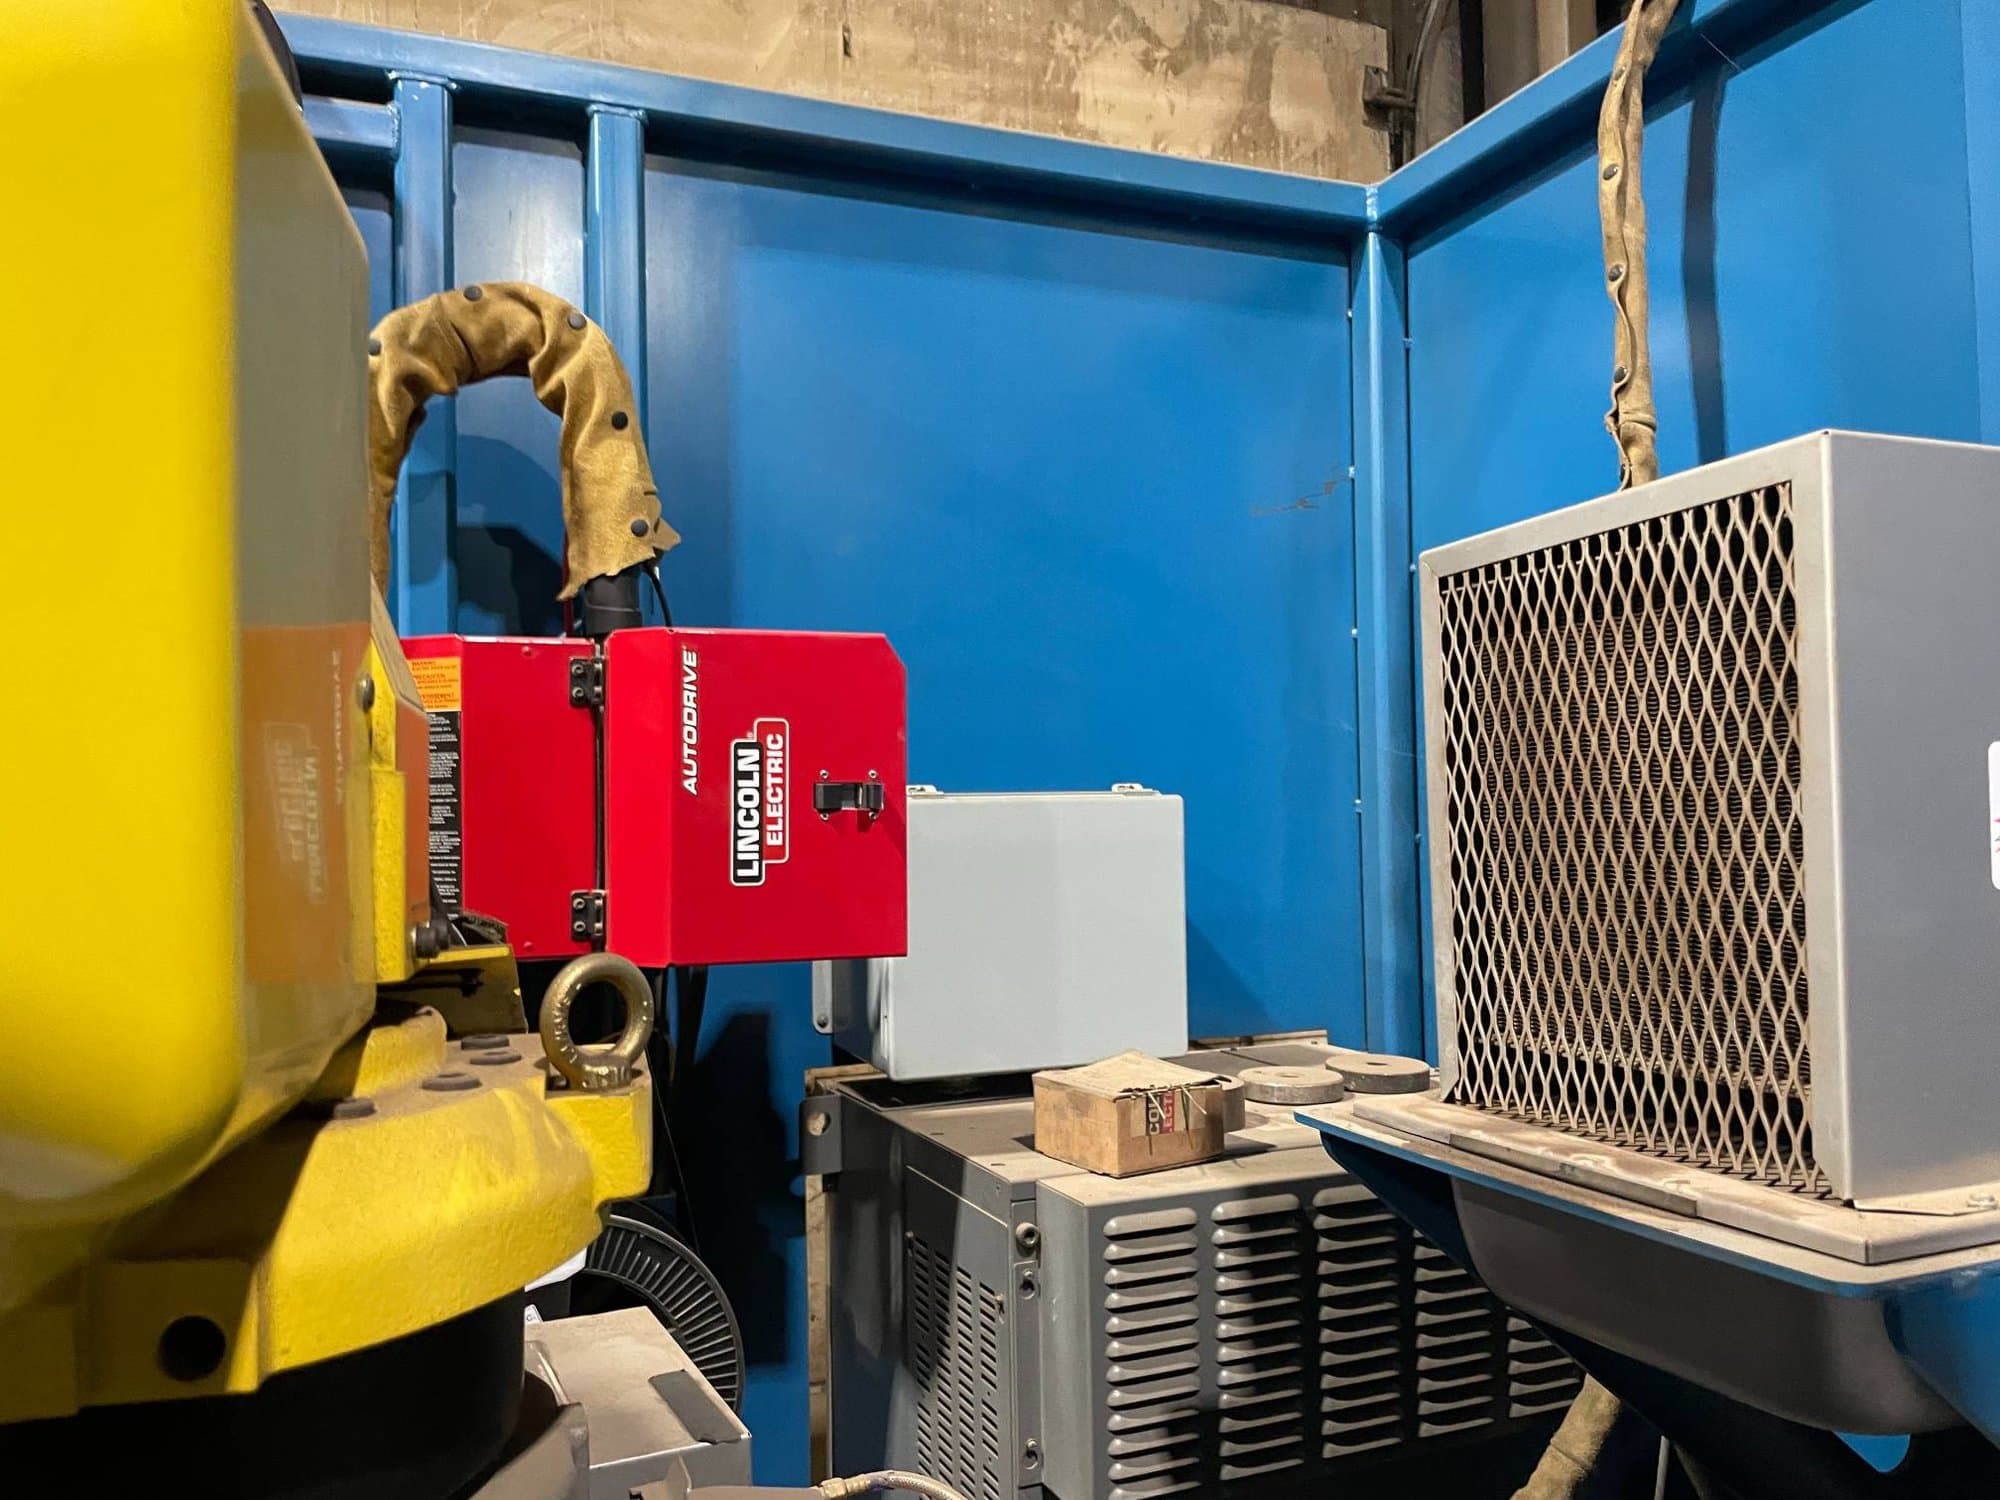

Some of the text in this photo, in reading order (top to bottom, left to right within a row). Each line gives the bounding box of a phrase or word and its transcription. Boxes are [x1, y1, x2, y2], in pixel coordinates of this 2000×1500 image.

[682, 650, 698, 796] AUTODRIVE
[737, 748, 760, 877] LINCOLN
[766, 733, 784, 846] ELECTRIC
